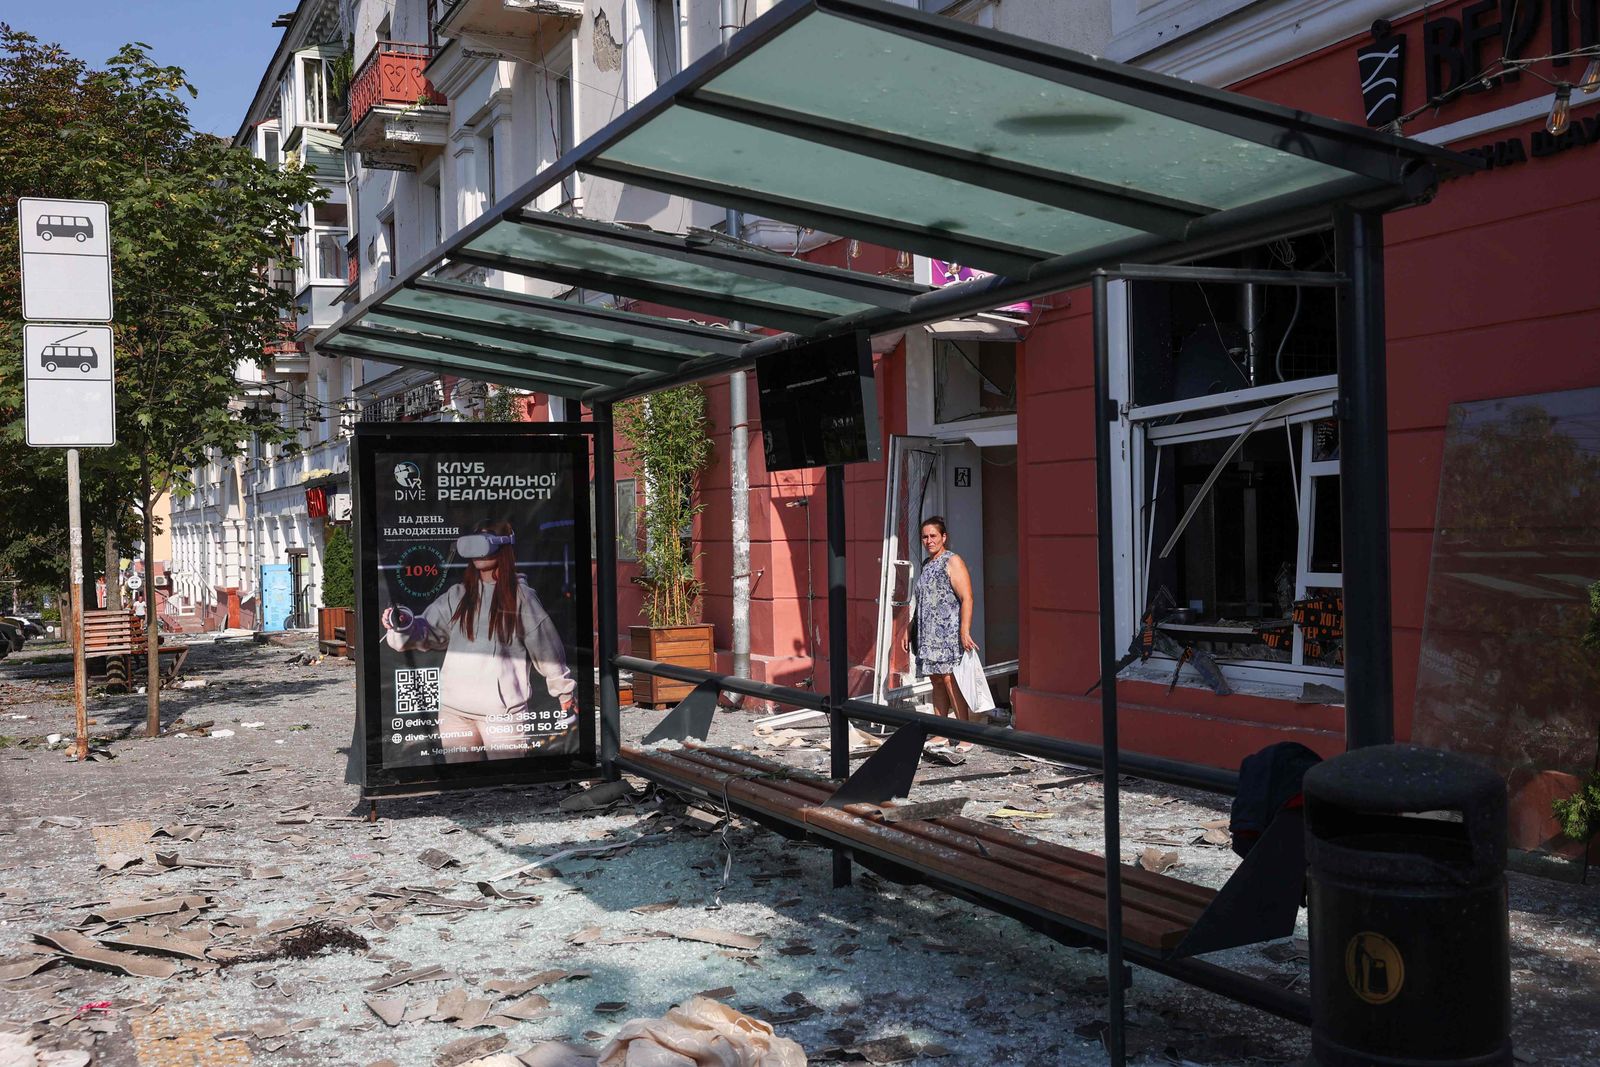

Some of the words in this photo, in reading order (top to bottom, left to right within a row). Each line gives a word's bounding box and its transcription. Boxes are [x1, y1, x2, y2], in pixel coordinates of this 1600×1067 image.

[437, 462, 485, 474] КЛУБ
[407, 478, 422, 490] VR
[437, 472, 557, 487] ВІРТУАЛЬНОЇ
[437, 488, 552, 501] РЕАЛЬНОСТІ
[398, 515, 414, 524] НА
[415, 515, 445, 525] ДЕНЬ
[383, 527, 460, 537] НАРОДЖЕННЯ
[405, 564, 438, 577] 10%
[516, 711, 537, 721] 363
[539, 710, 551, 720] 18
[553, 710, 568, 719] 05
[405, 718, 445, 728] @dive_vr
[516, 723, 535, 732] 091
[537, 722, 552, 731] 50
[554, 721, 569, 730] 26
[405, 730, 473, 742] dive-vr.com.ua
